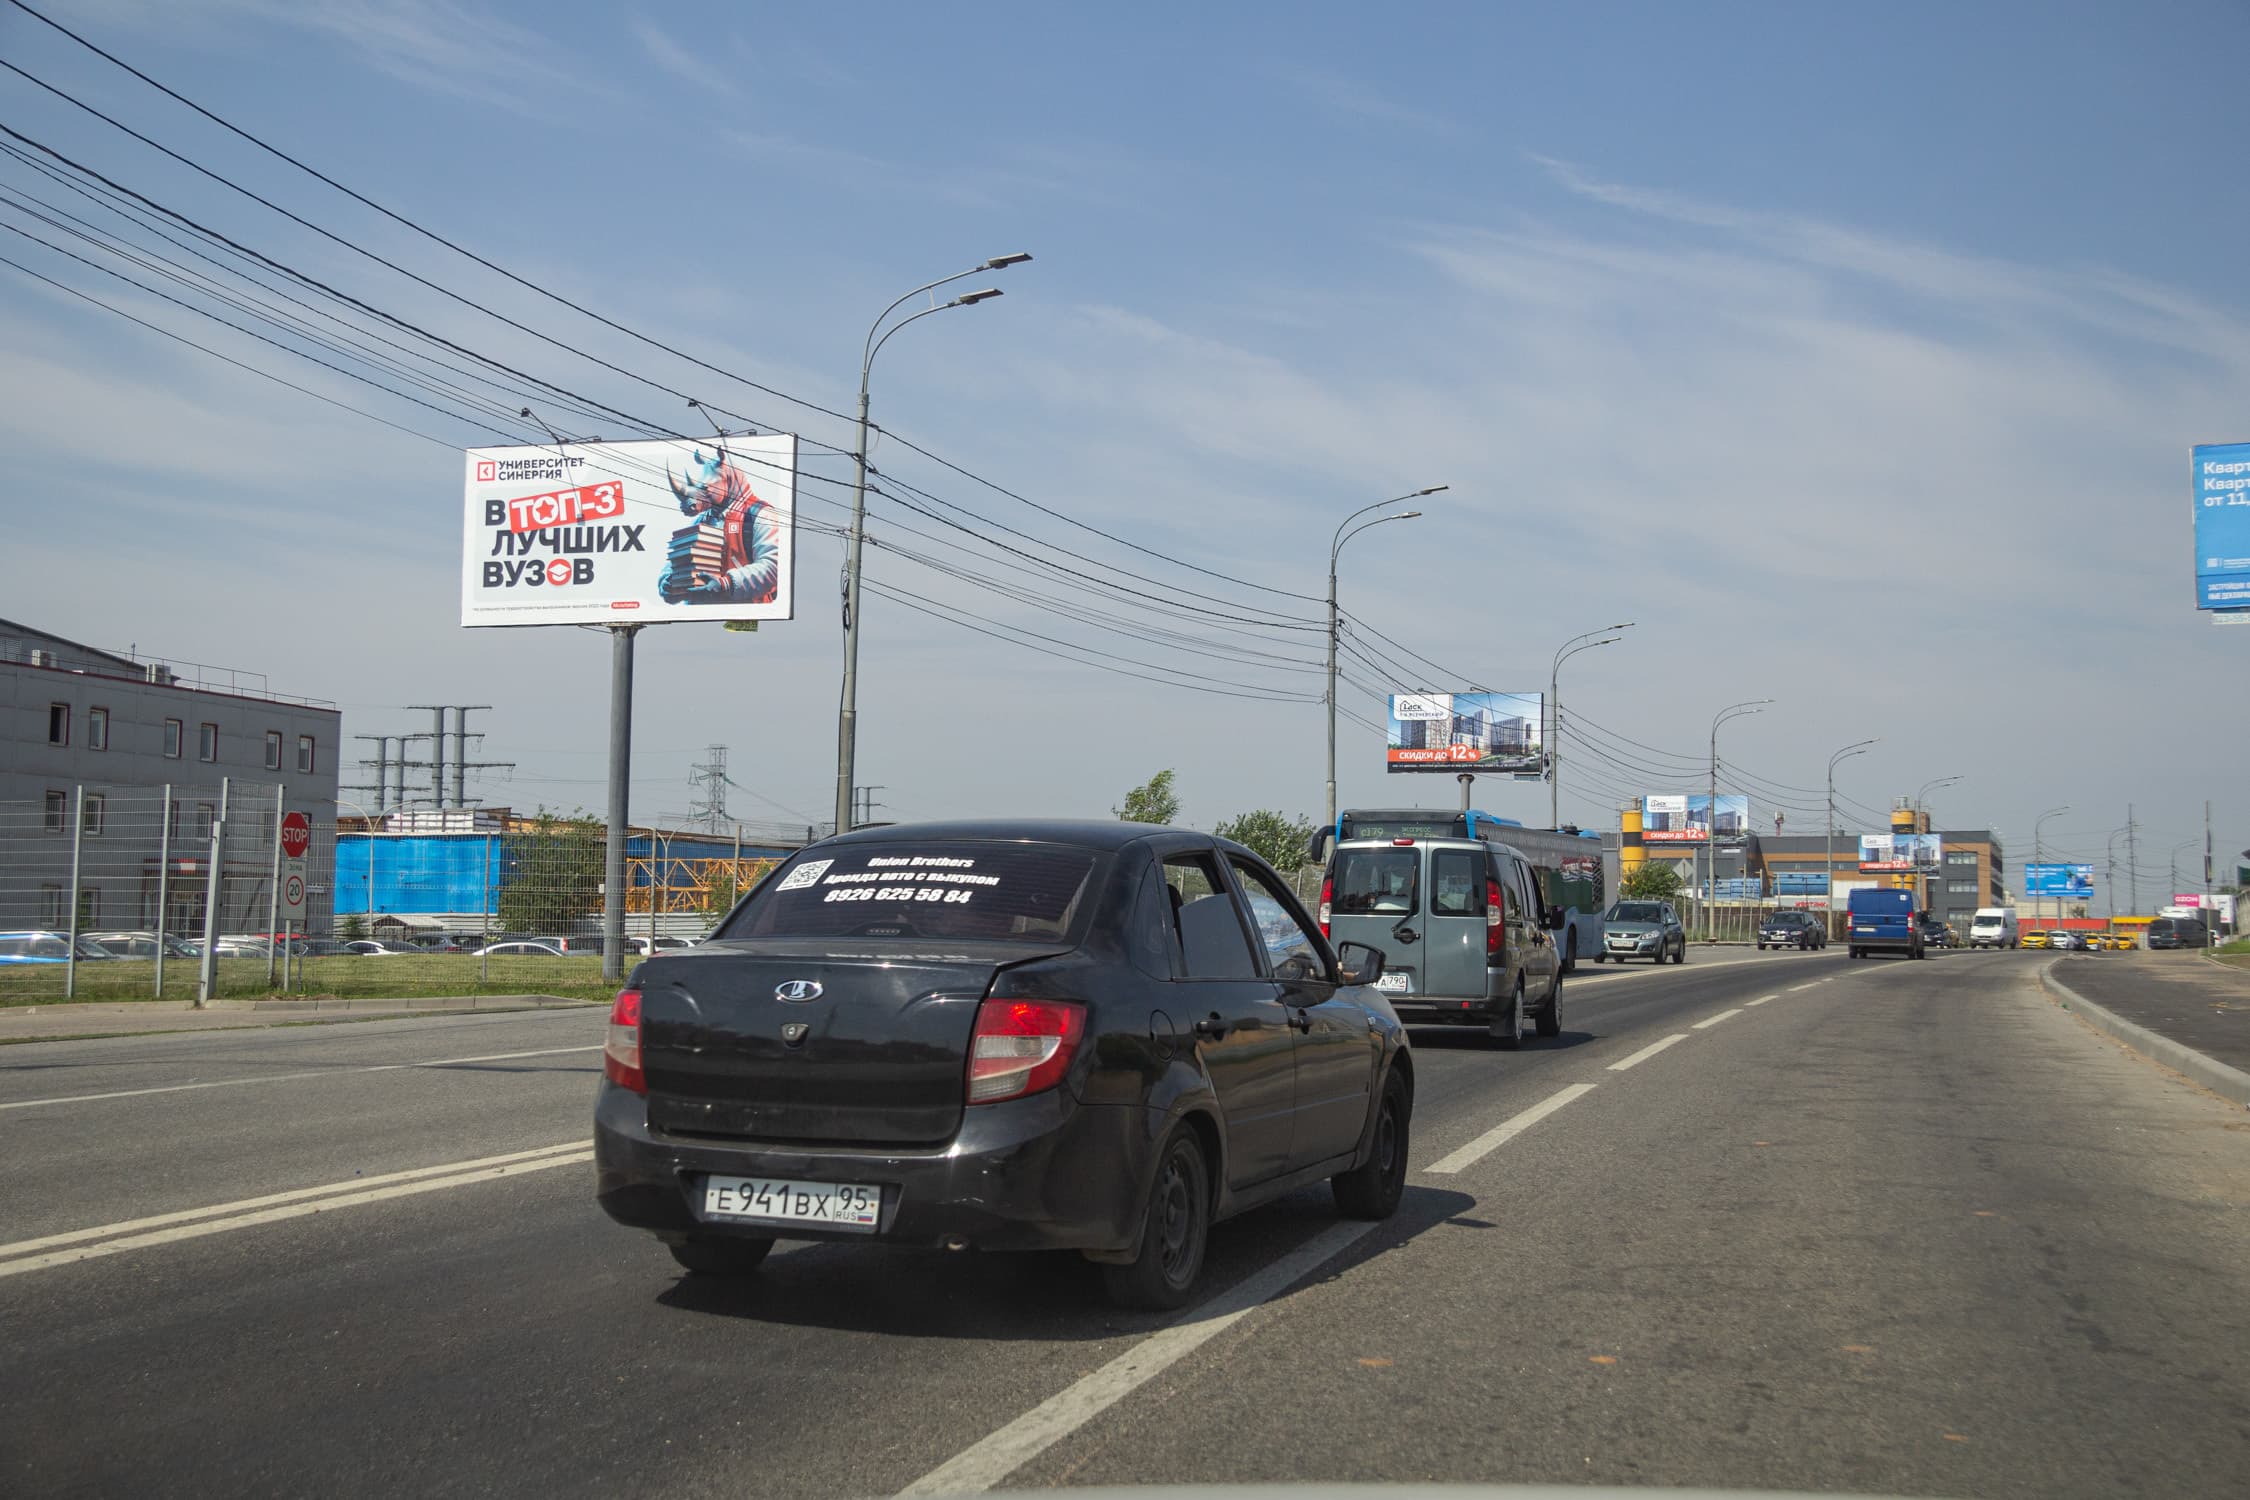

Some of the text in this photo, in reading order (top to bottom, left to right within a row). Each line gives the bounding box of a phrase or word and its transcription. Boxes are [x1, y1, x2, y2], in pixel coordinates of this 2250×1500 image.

[498, 457, 585, 470] УНИВЕРСИТЕТ
[498, 469, 563, 481] СИНЕРГИЯ
[2204, 497, 2225, 507] от
[485, 499, 506, 526] В
[491, 524, 646, 556] ЛУЧШИХ
[482, 558, 595, 588] ВУЗОВ
[1399, 751, 1433, 760] СКИДКИ
[1434, 752, 1448, 760] ДО
[1450, 746, 1467, 759] 12
[283, 828, 308, 843] STOP
[1686, 829, 1698, 839] 12
[867, 856, 975, 867] Union Brothers
[823, 872, 879, 885] Аренда
[879, 872, 915, 881] авто
[927, 873, 1000, 886] выкупом
[289, 884, 300, 896] 20
[823, 888, 973, 904] 8926 625 58 84
[1389, 976, 1405, 985] 790
[717, 1182, 868, 1217] Е941ВХ 95
[835, 1211, 857, 1221] RUS
